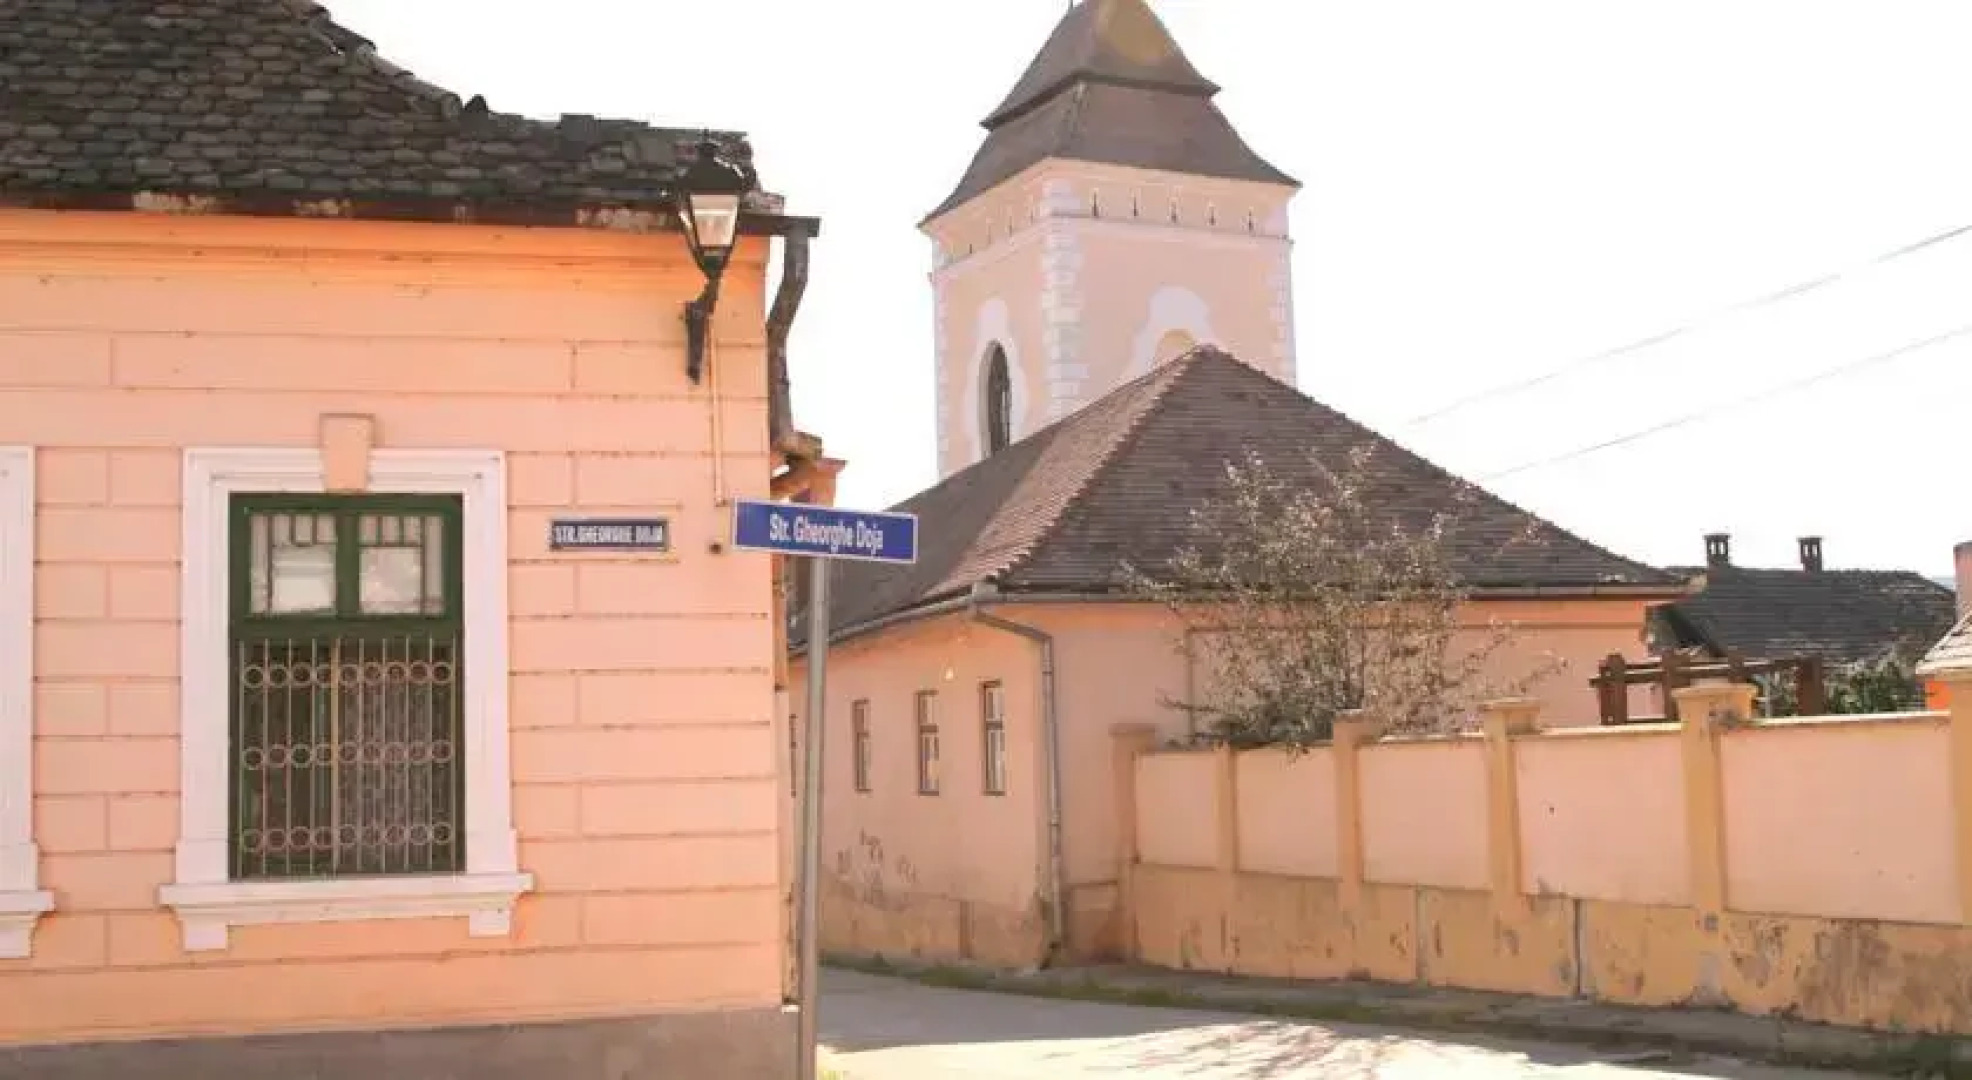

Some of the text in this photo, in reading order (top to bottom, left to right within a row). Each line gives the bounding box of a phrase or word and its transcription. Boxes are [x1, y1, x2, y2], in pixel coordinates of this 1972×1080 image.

[769, 513, 883, 555] Str. Gheorghe Doja
